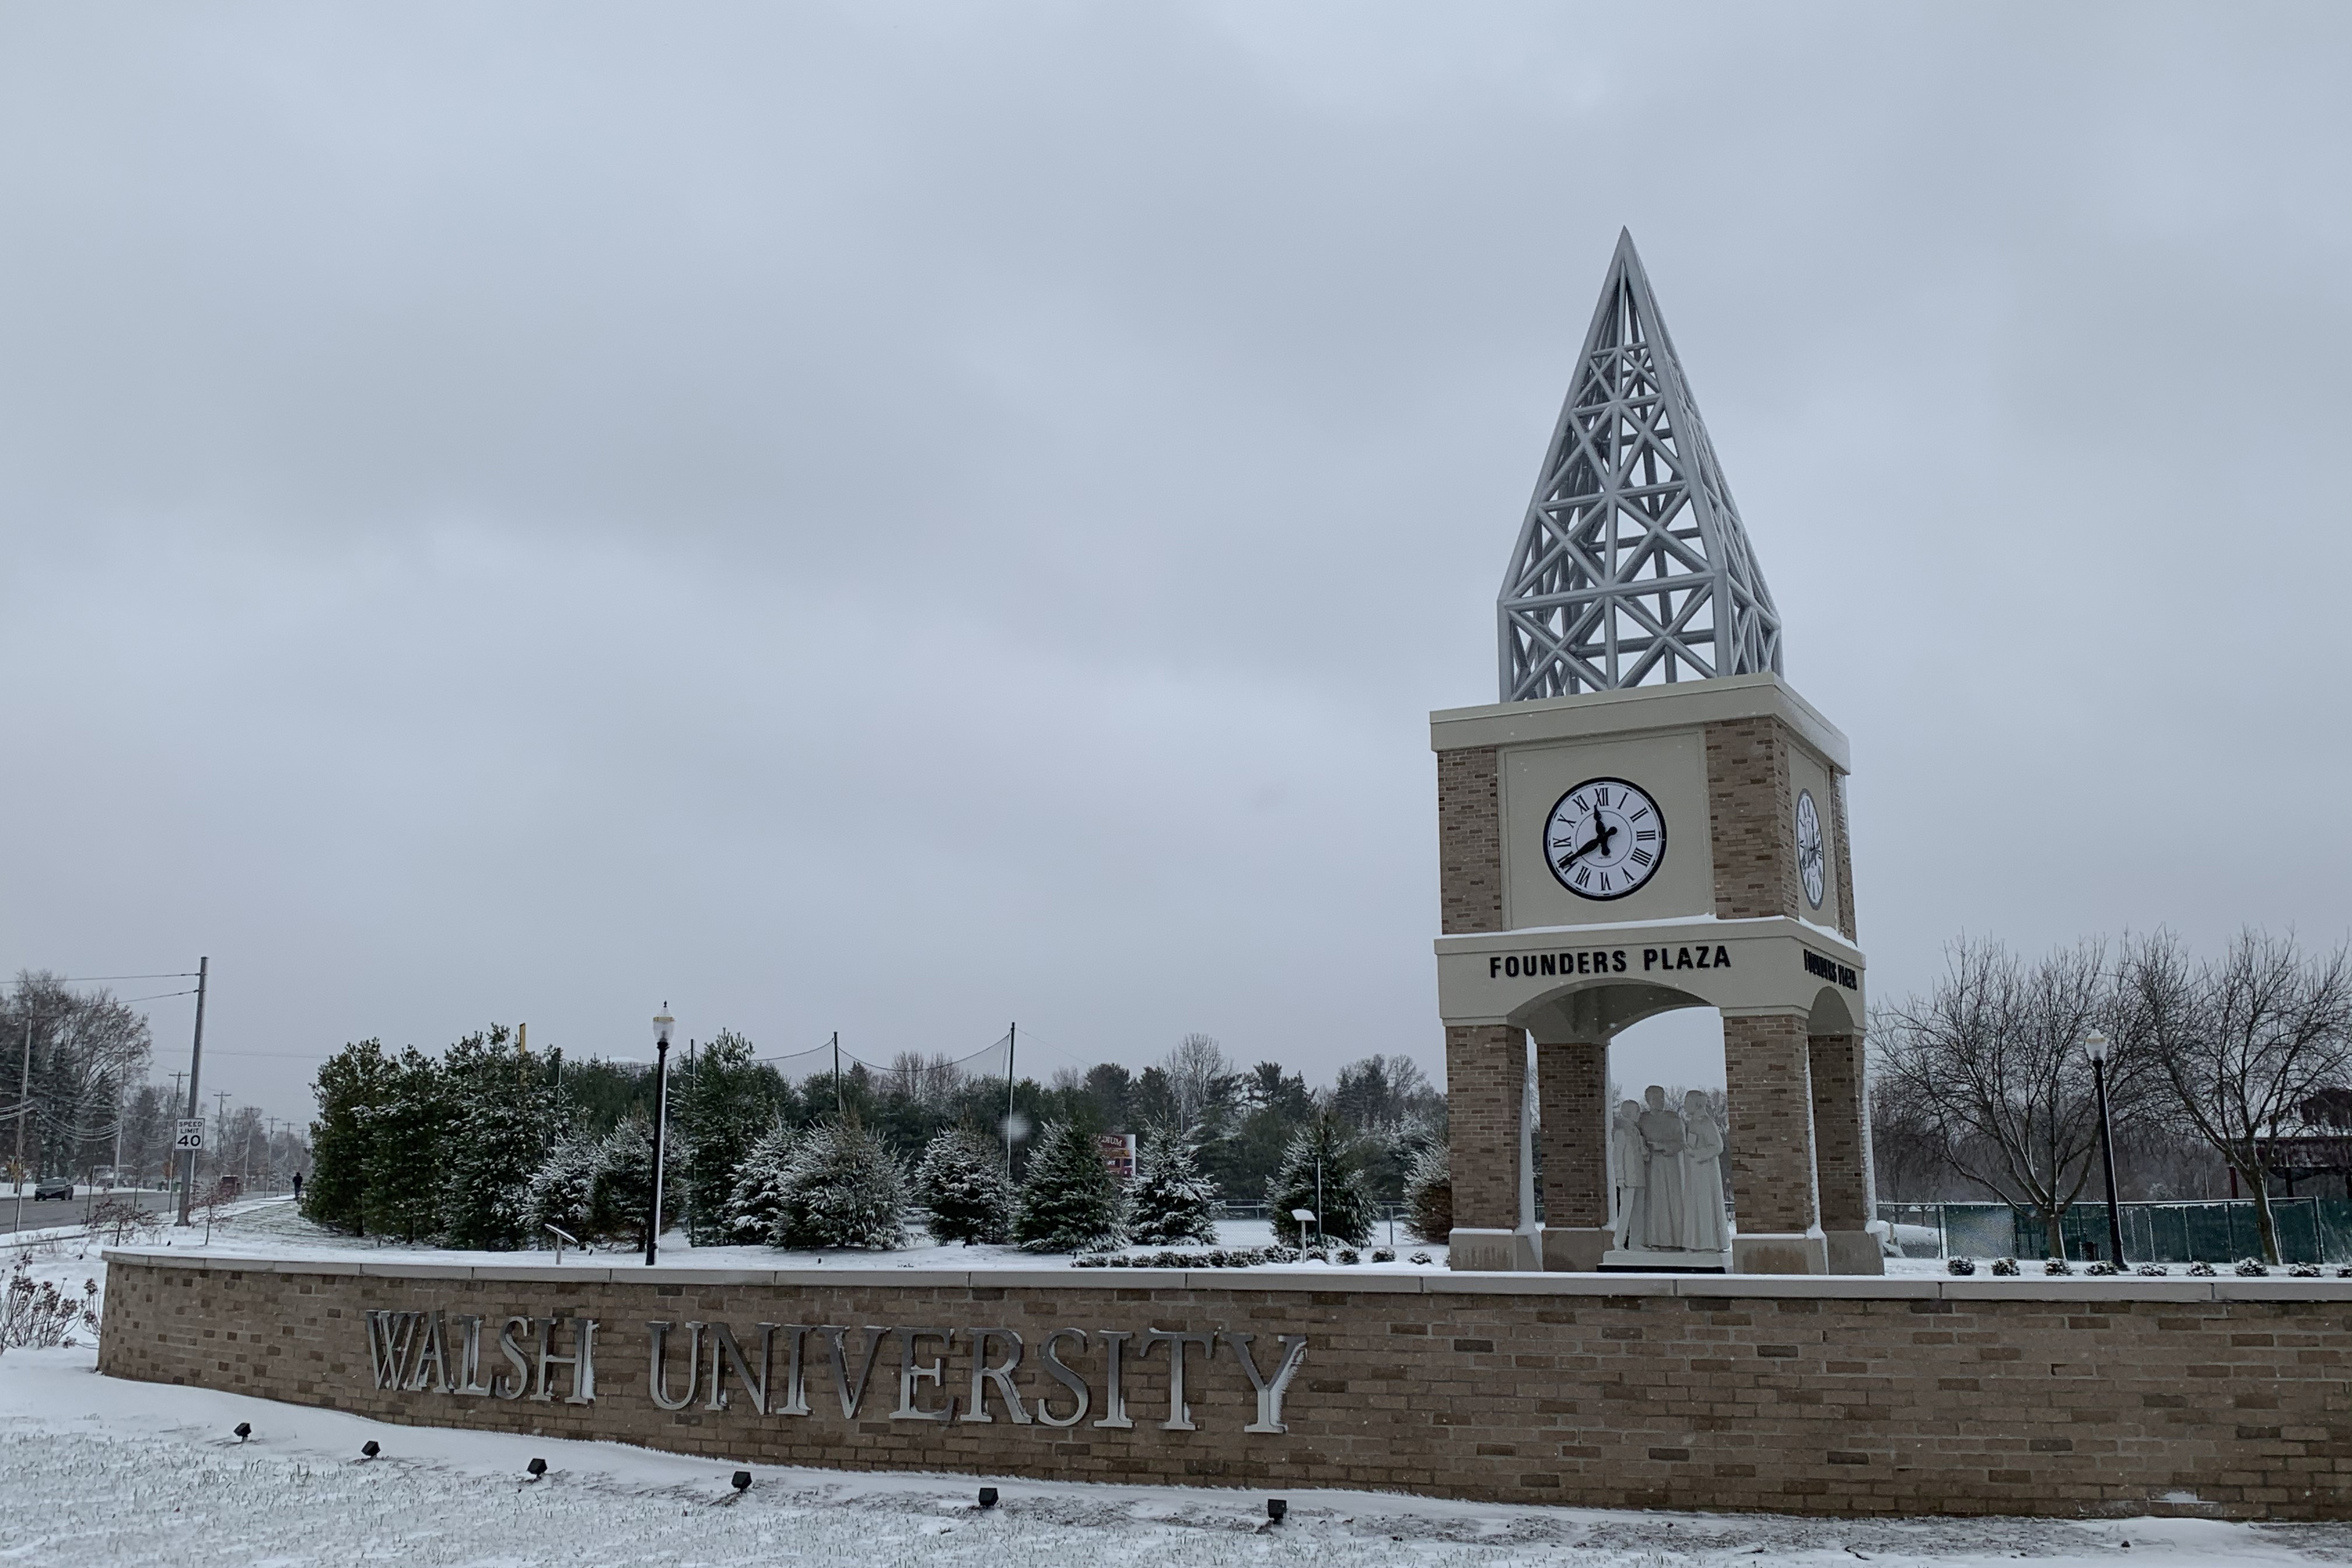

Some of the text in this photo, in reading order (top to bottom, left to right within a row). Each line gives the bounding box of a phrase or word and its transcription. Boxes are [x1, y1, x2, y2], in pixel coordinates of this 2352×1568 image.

[1572, 794, 1591, 816] XI
[1594, 788, 1610, 807] XII
[1616, 792, 1629, 810] I
[1557, 814, 1577, 828] X
[1630, 807, 1649, 824] II
[1552, 836, 1572, 848] IX
[1636, 829, 1656, 842] III
[1557, 850, 1578, 876] VI
[1574, 865, 1592, 889] VII
[1600, 872, 1612, 891] VI
[1621, 866, 1636, 884] V
[1489, 945, 1731, 978] FOUNDERS PLAZA
[177, 1135, 201, 1147] 40
[366, 1309, 1308, 1434] WALSH UNIVERSITY
